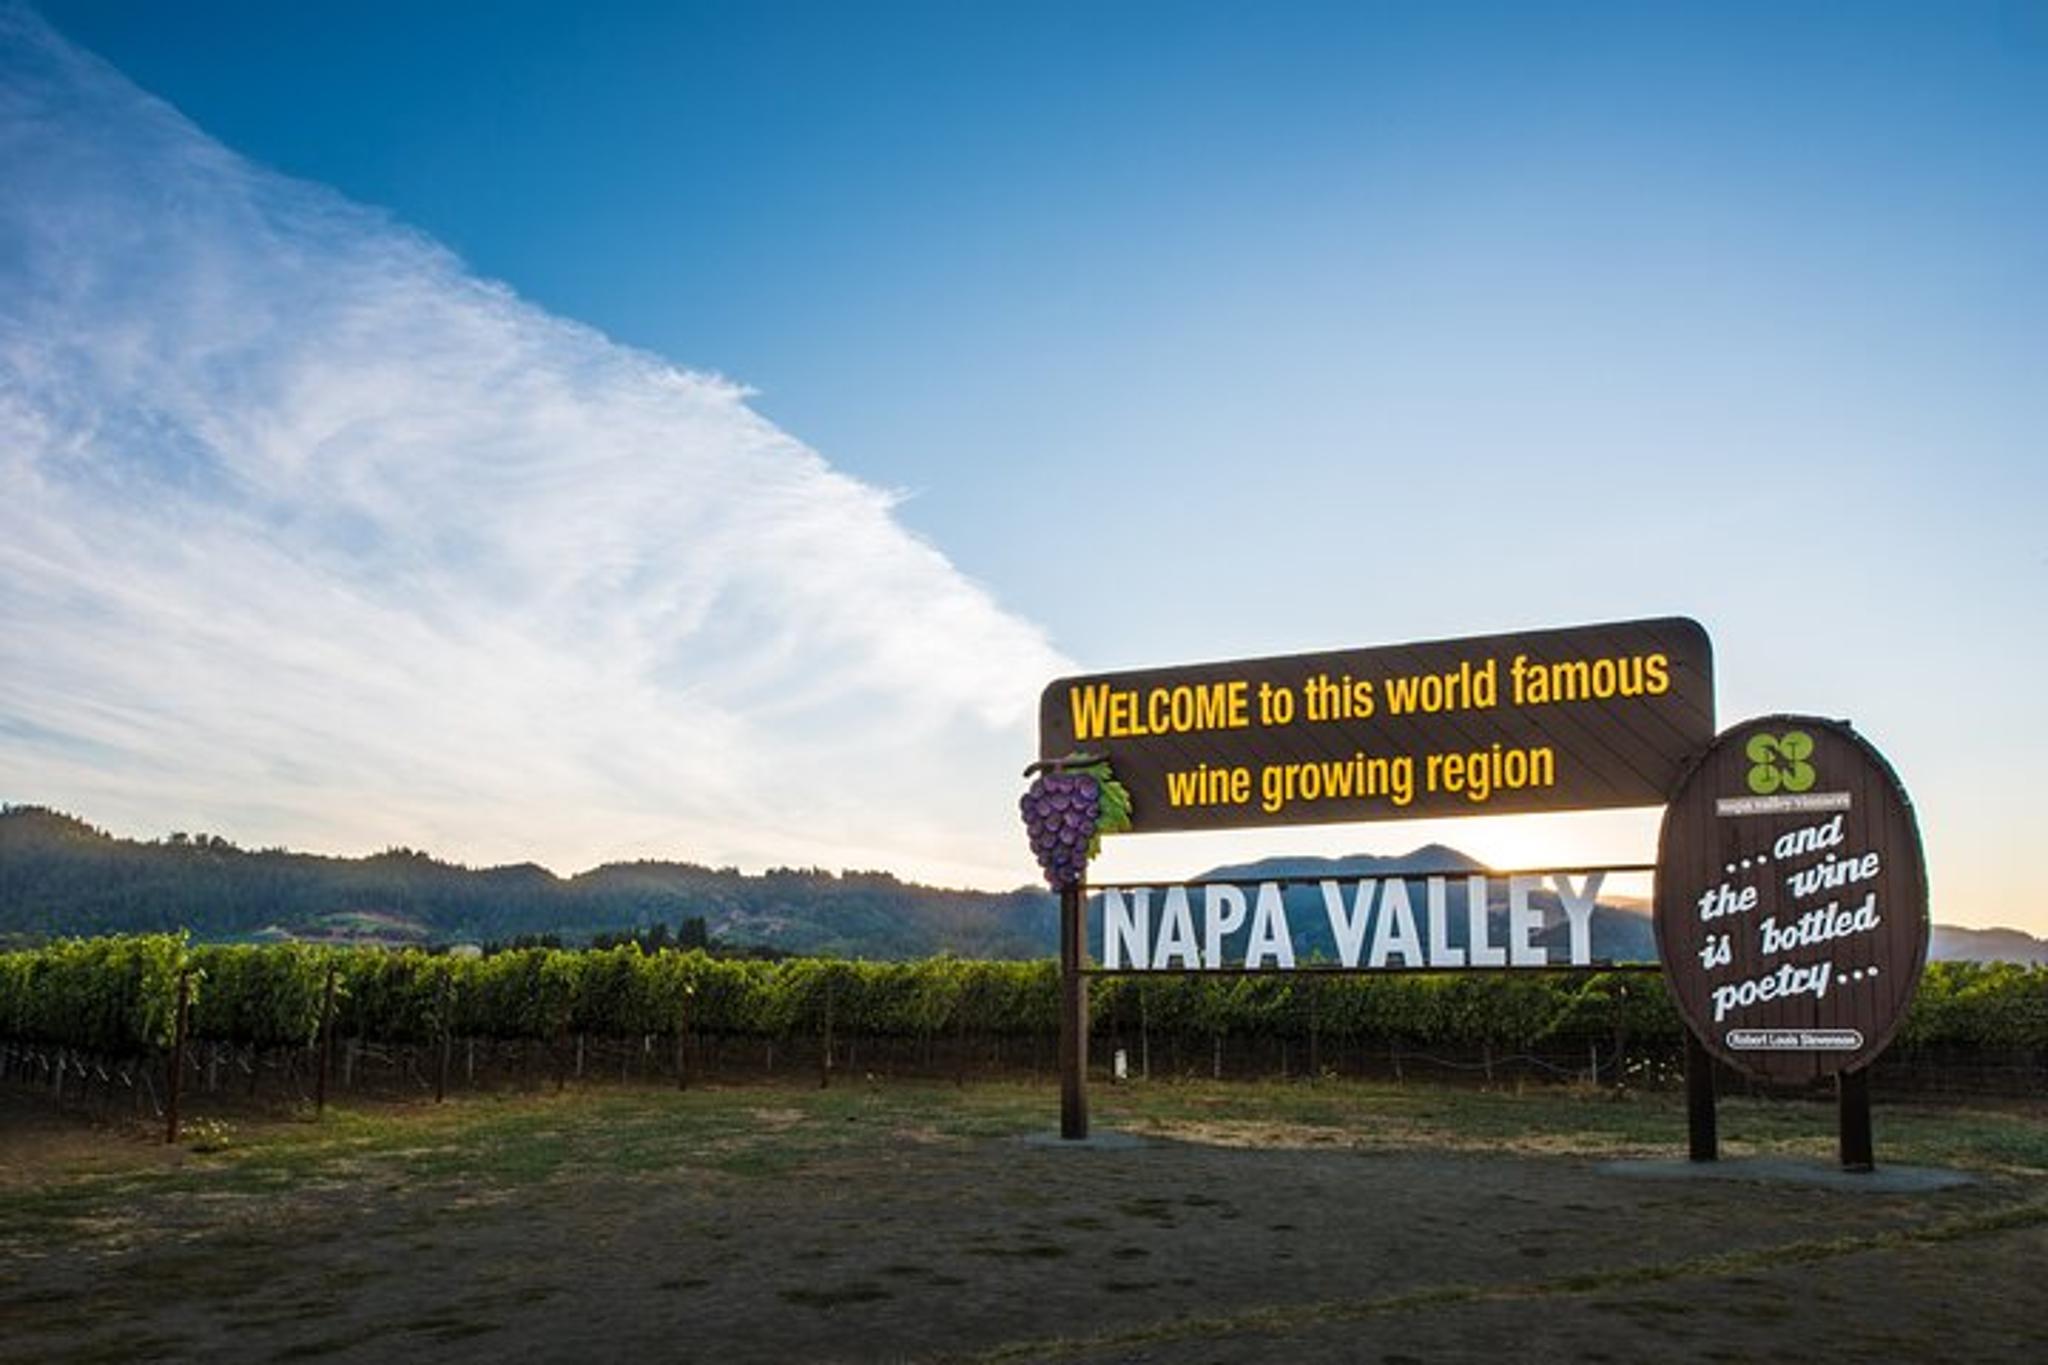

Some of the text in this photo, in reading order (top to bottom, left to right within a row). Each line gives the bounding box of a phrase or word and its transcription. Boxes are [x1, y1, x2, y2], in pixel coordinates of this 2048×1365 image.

[1071, 654, 1669, 739] WELCOME to this world famous
[1167, 744, 1554, 812] wine growing region
[1103, 872, 1607, 969] NAPA VALLEY
[1698, 851, 1879, 921] the wine
[1699, 893, 1880, 969] is bottled
